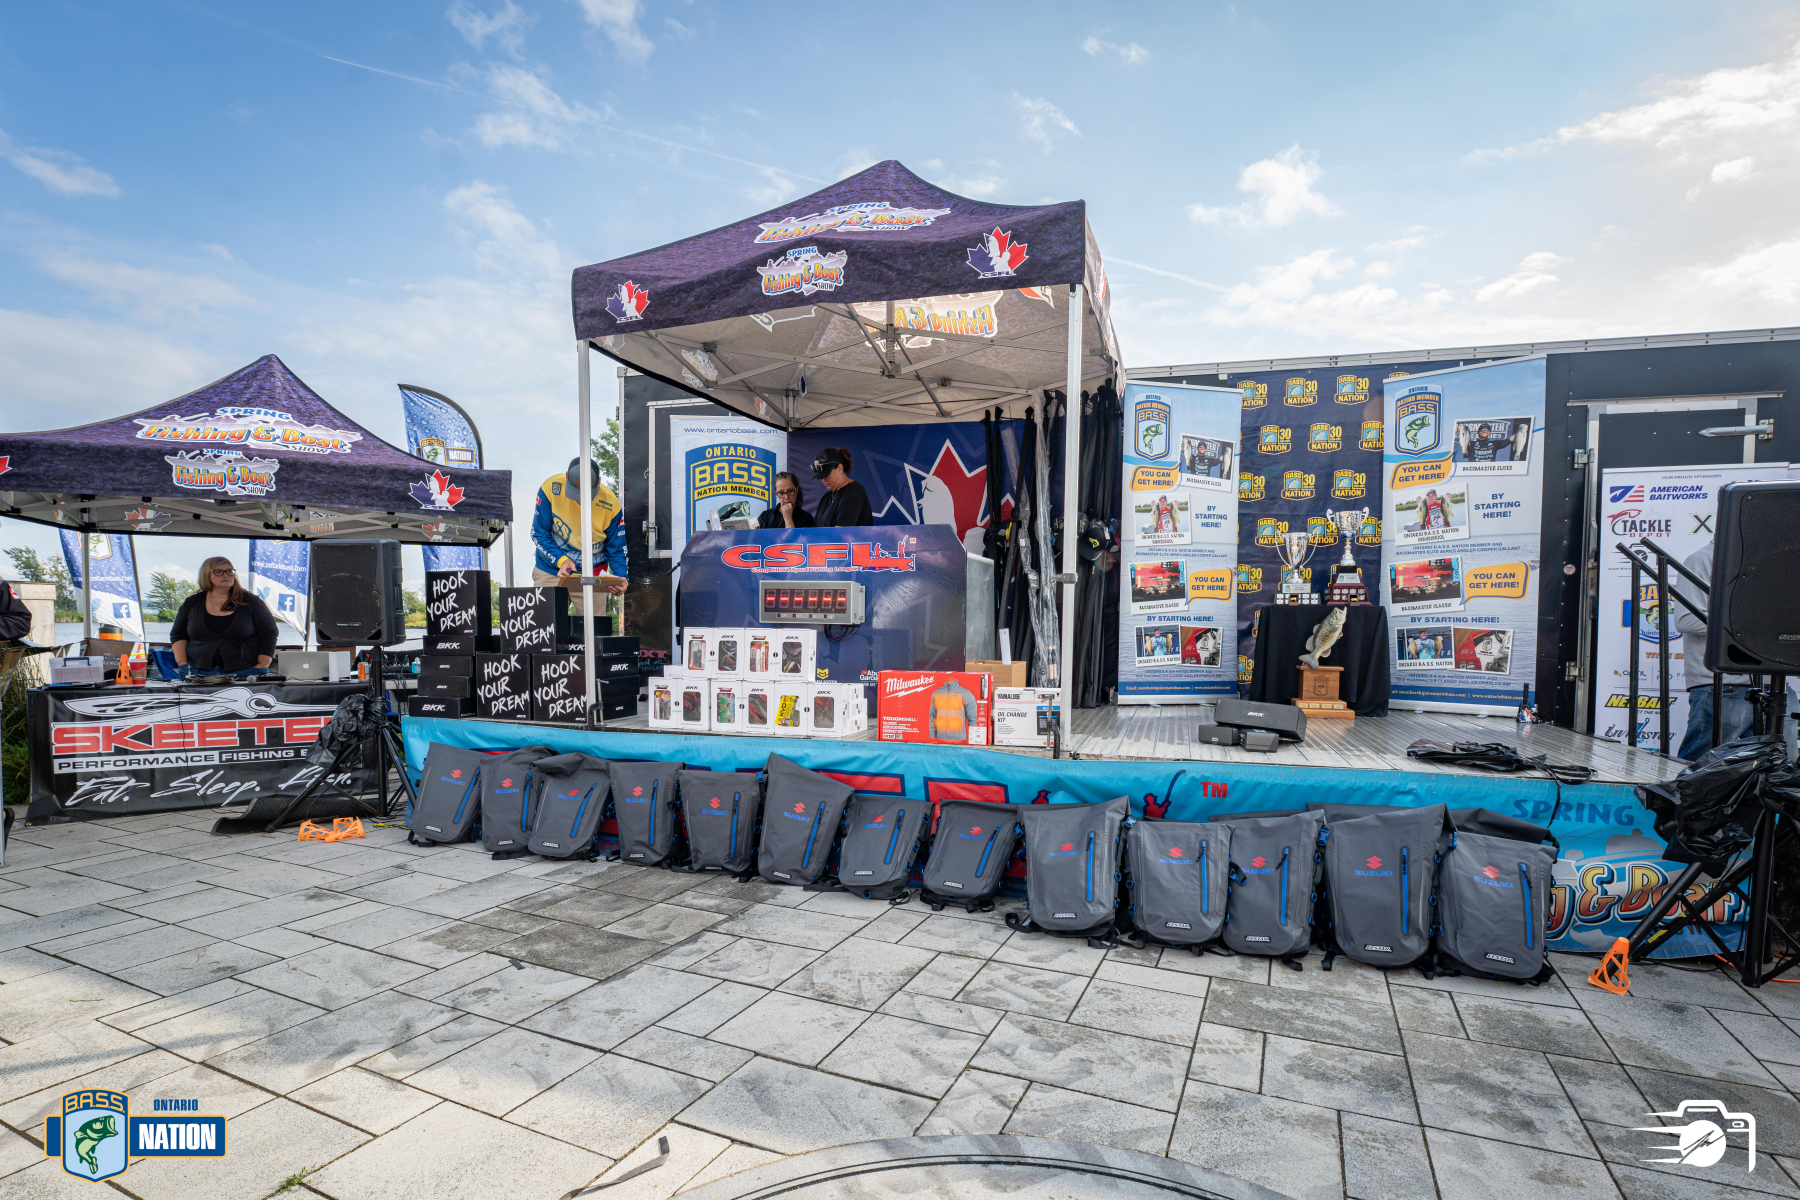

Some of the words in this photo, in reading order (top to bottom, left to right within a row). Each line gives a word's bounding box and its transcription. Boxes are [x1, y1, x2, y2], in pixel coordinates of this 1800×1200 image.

[827, 202, 889, 214] SPRING
[759, 219, 848, 242] Fishing
[846, 212, 870, 226] &
[869, 211, 929, 227] Boat
[787, 247, 818, 258] SPRING
[763, 273, 802, 294] Fishing
[803, 265, 815, 283] &
[814, 263, 841, 285] Boat
[817, 281, 835, 291] SHOW
[1256, 384, 1267, 394] 30
[1306, 381, 1318, 392] 30
[1357, 378, 1369, 389] 30
[1408, 386, 1428, 394] ONTARIO
[1338, 394, 1365, 402] NATION
[1397, 395, 1416, 406] NATION
[1416, 394, 1440, 402] MEMBER
[219, 407, 293, 420] SPRING
[684, 426, 778, 435] www.ontariobass.com
[1280, 428, 1292, 439] 30
[1330, 426, 1342, 438] 30
[143, 425, 250, 443] Fishing
[251, 427, 280, 442] &
[281, 429, 345, 451] Boat
[1261, 444, 1287, 452] NATION
[1311, 442, 1338, 450] NATION
[203, 448, 242, 457] SPRING
[449, 450, 471, 461] NATION
[705, 446, 757, 459] ONTARIO
[695, 462, 769, 489] B.A.S.S.
[1402, 465, 1420, 474] YOU
[175, 466, 226, 489] Fishing
[227, 467, 240, 484] &
[240, 467, 273, 485] Boat
[1254, 476, 1265, 487] 30
[1303, 474, 1316, 486] 30
[1354, 473, 1366, 485] 30
[1398, 474, 1417, 482] GET
[1418, 472, 1445, 481] HERE!
[246, 486, 266, 495] SHOW
[697, 485, 728, 498] NATION
[730, 486, 766, 498] MEMBER
[1335, 489, 1361, 497] NATION
[1649, 485, 1703, 493] AMERICAN
[1649, 492, 1709, 501] BAITWORKS
[1474, 501, 1521, 510] STARTING
[1482, 511, 1512, 519] HERE!
[1276, 521, 1289, 533] 30
[1622, 519, 1672, 533] TACKLE
[721, 543, 875, 570] CSFL
[1250, 568, 1263, 579] 30
[433, 569, 468, 599] HOOK
[1490, 581, 1520, 589] HERE!
[426, 592, 459, 621] YOUR
[508, 586, 547, 617] HOOK
[440, 605, 477, 633] DREAM
[501, 609, 536, 640] YOUR
[515, 622, 555, 651] DREAM
[483, 653, 521, 682] HOOK
[541, 655, 581, 684] HOOK
[477, 675, 512, 704] YOUR
[884, 675, 935, 693] Milwaukee
[533, 677, 570, 707] YOUR
[422, 704, 446, 712] BKK
[491, 689, 530, 716] DREAM
[52, 716, 333, 755] SKEETE
[57, 754, 216, 771] PERFORMANCE
[221, 749, 295, 762] FISHING
[440, 775, 466, 786] SUZUKI
[65, 777, 150, 807] Eat.
[151, 769, 261, 807] Sleep.
[1201, 781, 1228, 798] TM
[783, 811, 810, 823] SUZUKI
[1512, 799, 1636, 826] SPRING
[1050, 849, 1082, 858] SUZUKI
[1240, 867, 1275, 875] SUZUKI
[1354, 869, 1394, 877] SUZUKI
[1473, 875, 1514, 888] SUZUKI
